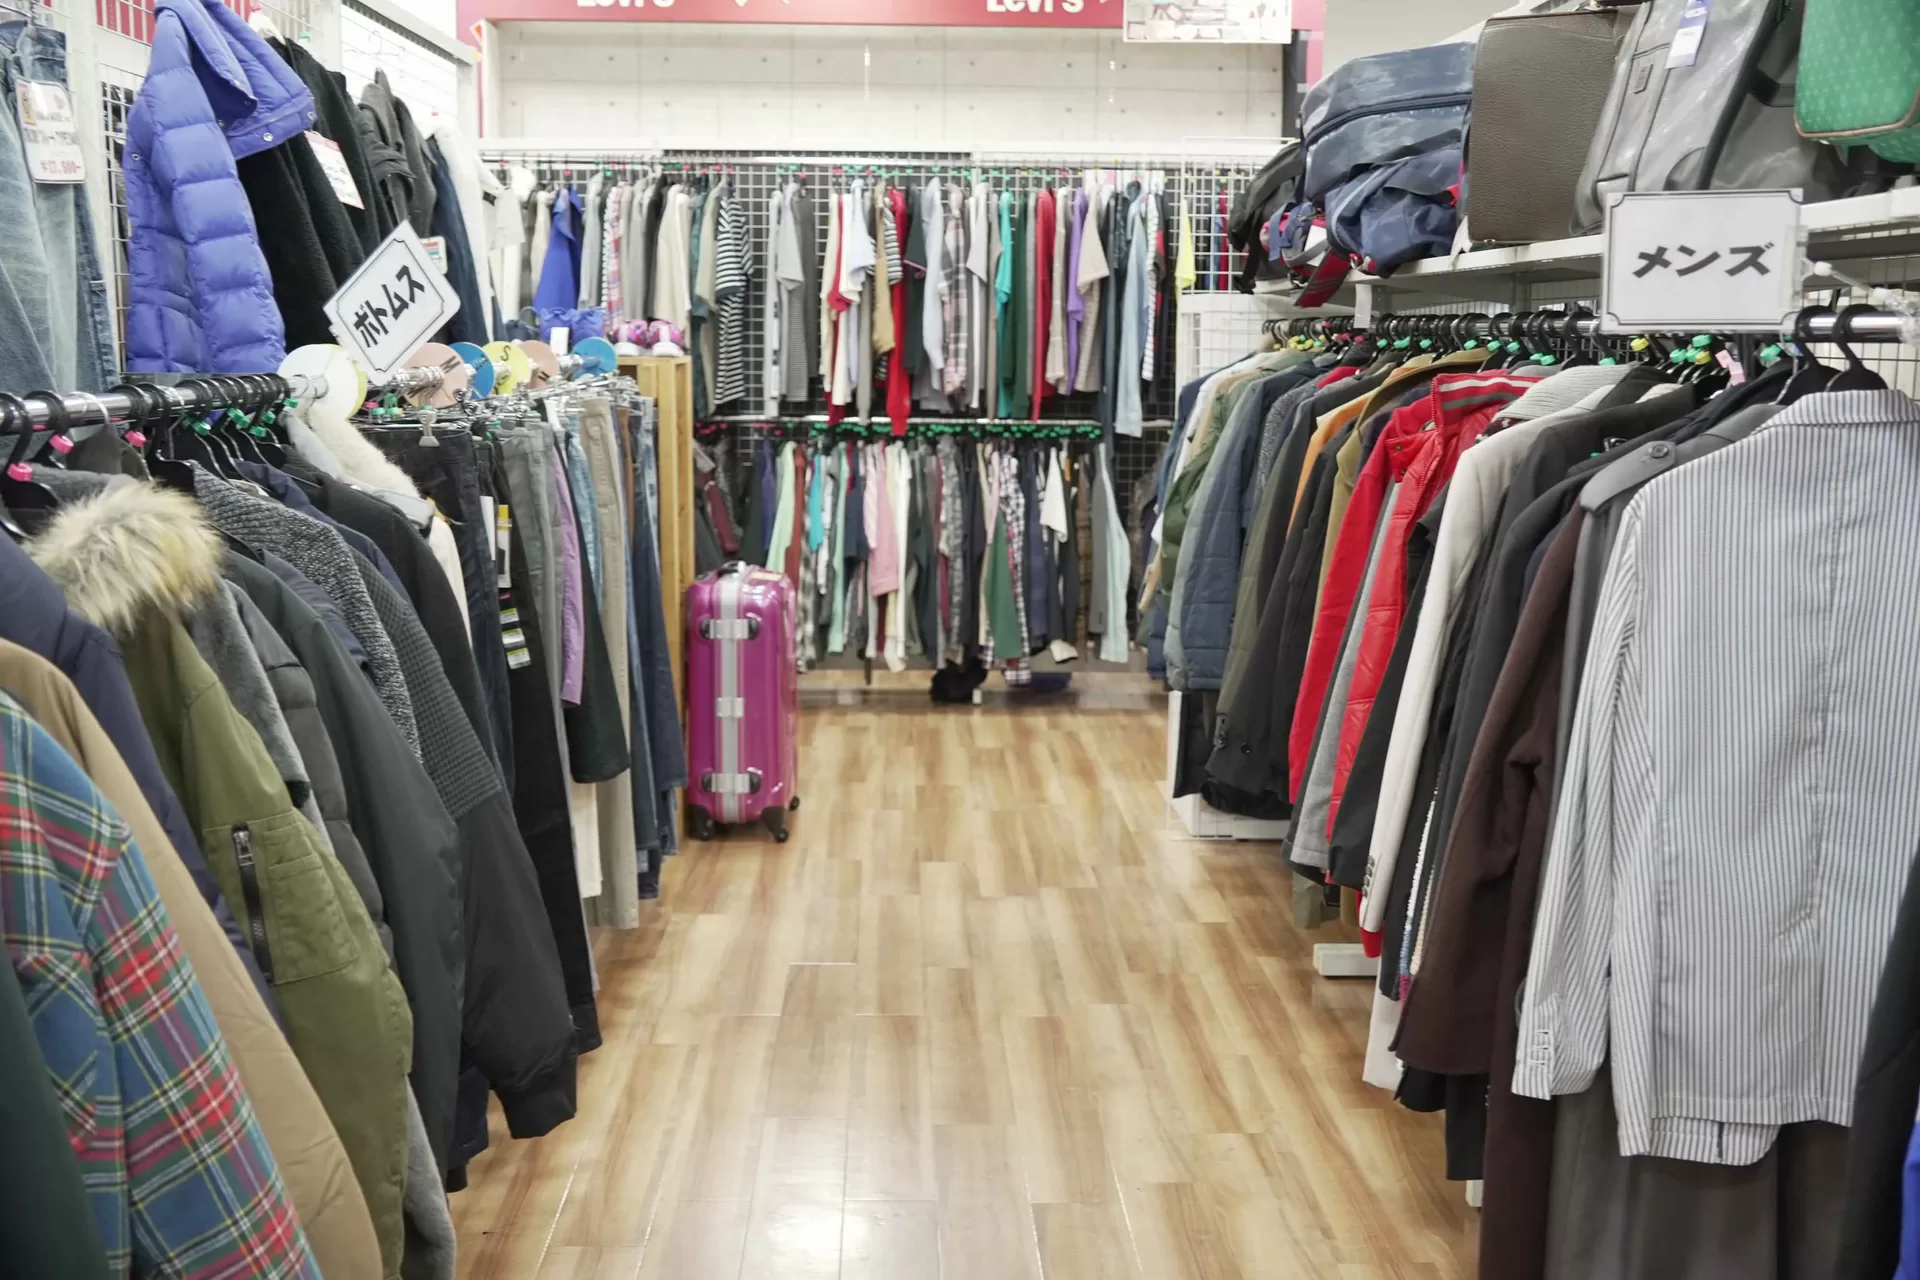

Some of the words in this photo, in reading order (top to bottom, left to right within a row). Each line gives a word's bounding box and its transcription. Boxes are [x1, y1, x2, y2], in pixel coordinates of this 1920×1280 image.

[1632, 241, 1775, 279] メンズ
[353, 265, 425, 348] ボトムス
[440, 354, 461, 374] M
[500, 345, 511, 361] S
